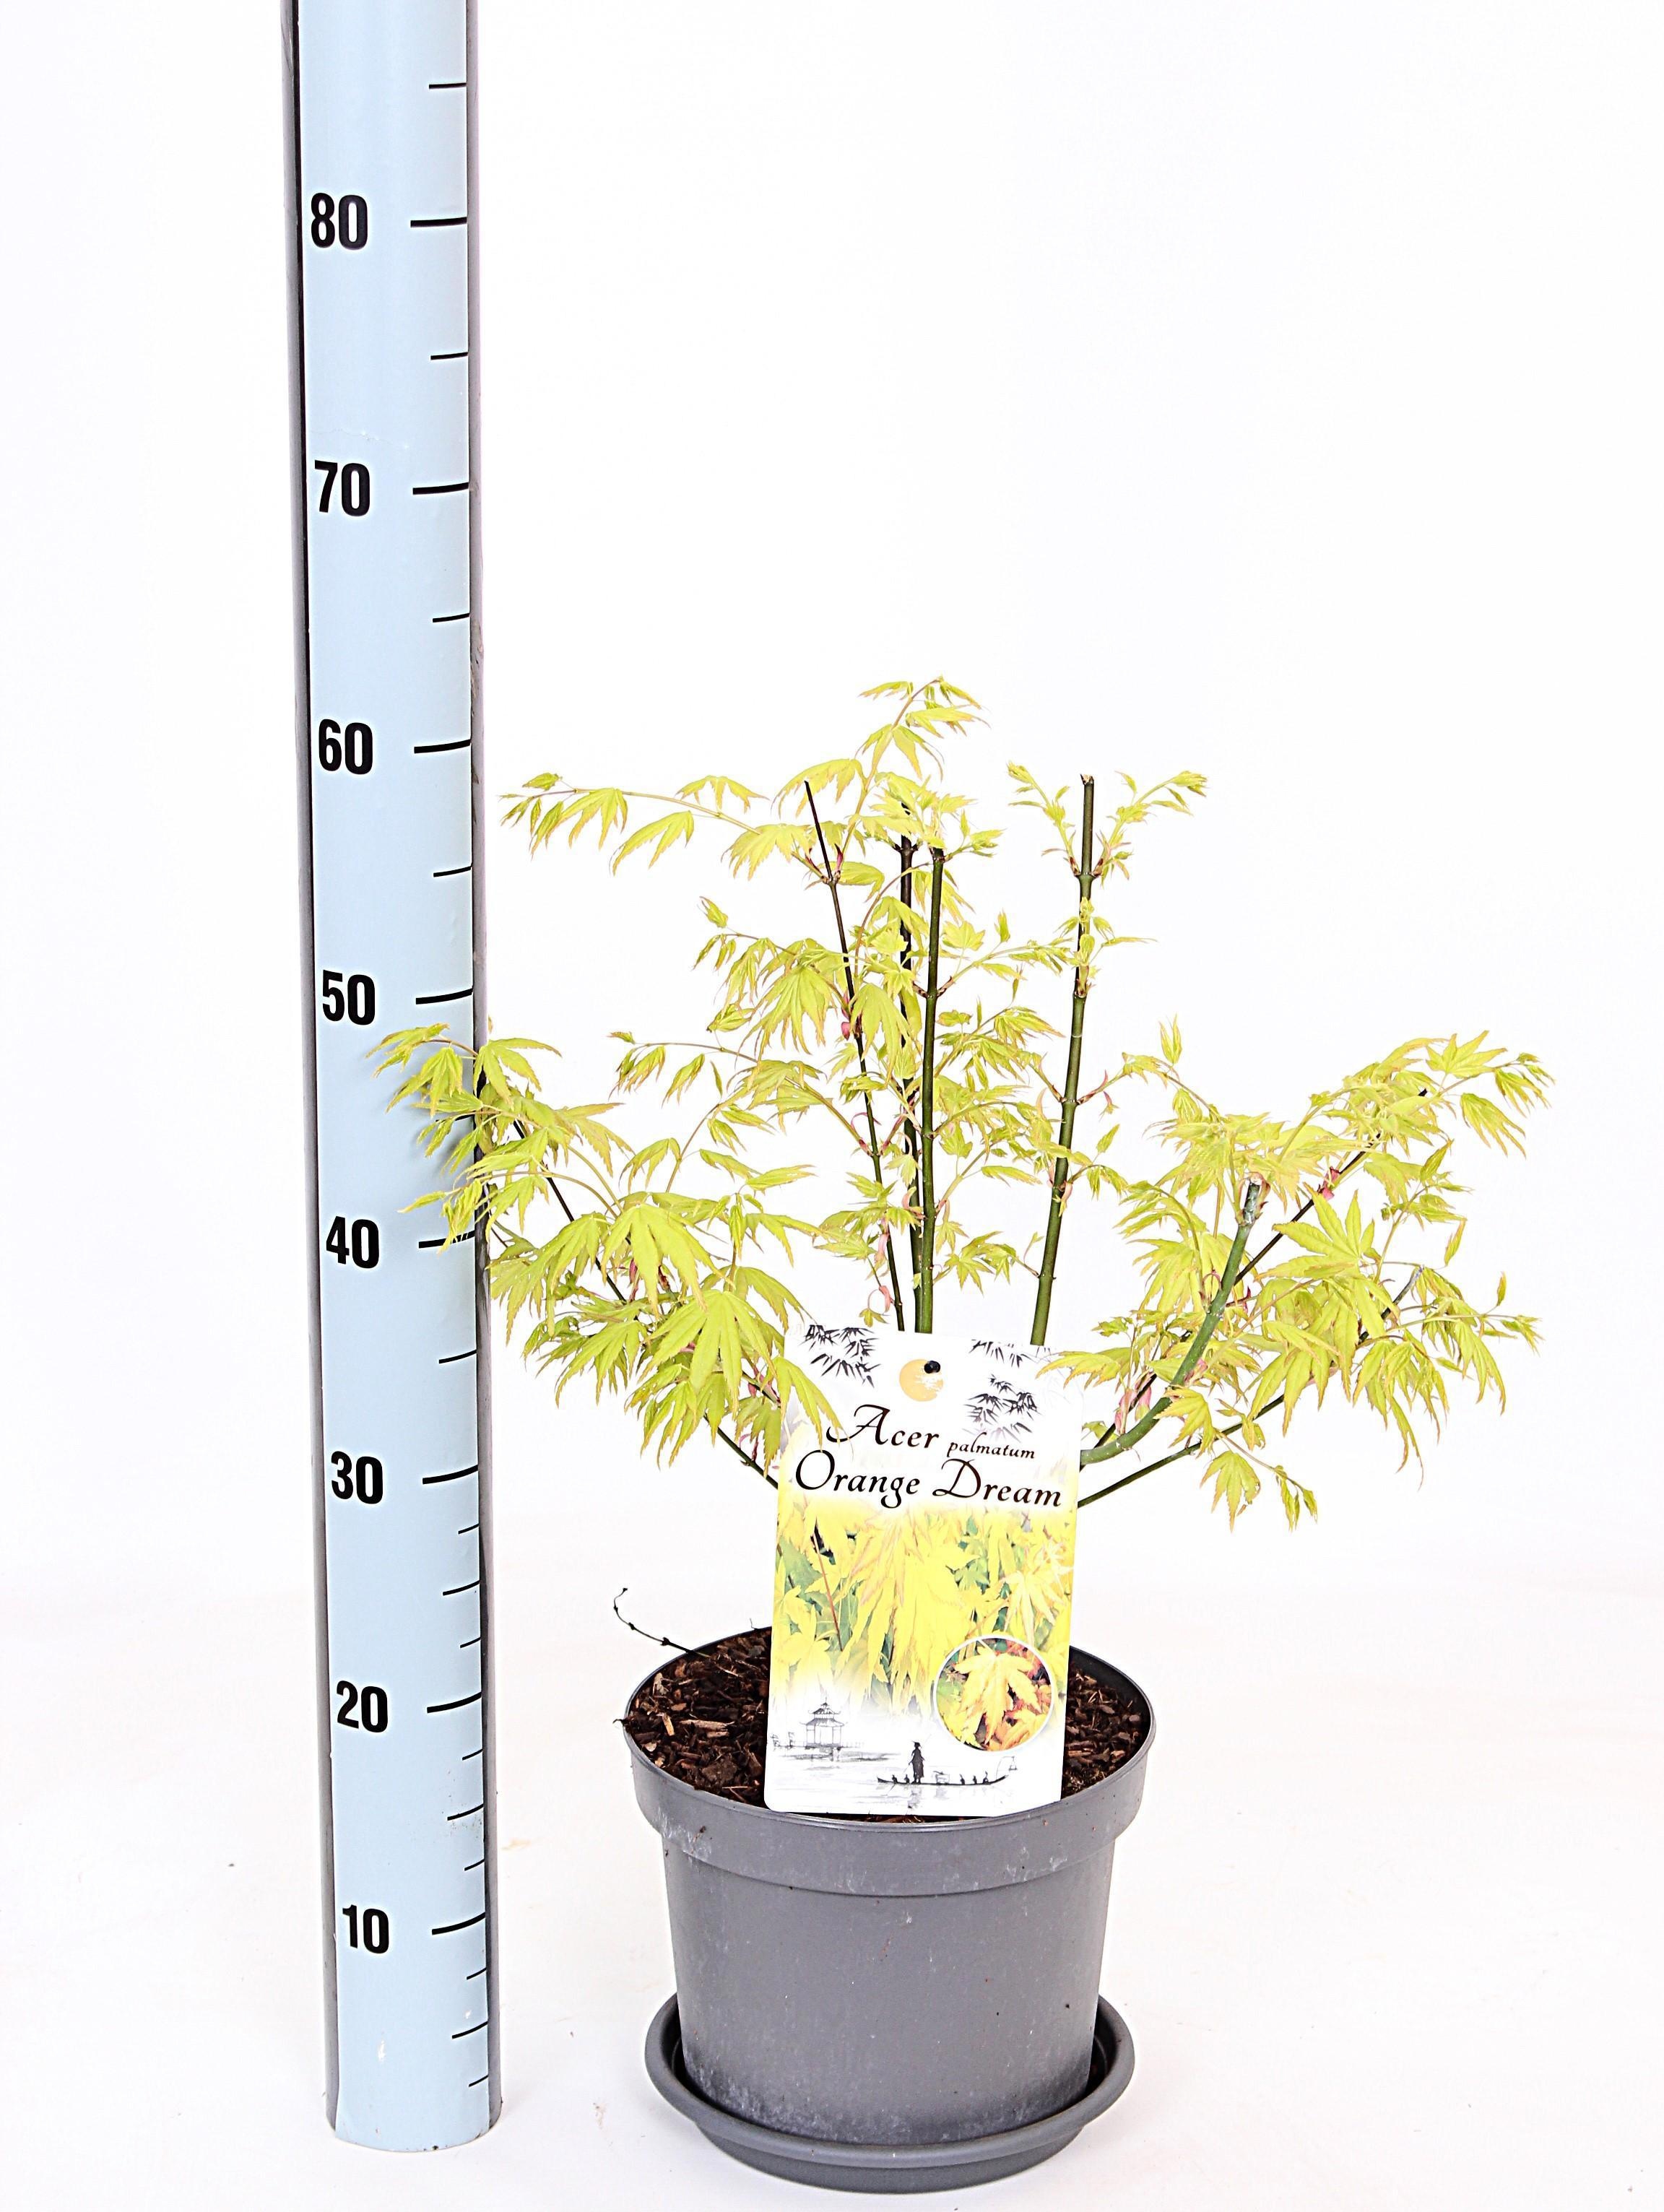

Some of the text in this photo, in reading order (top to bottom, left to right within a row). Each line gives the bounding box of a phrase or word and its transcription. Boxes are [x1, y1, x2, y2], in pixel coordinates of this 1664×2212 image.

[311, 193, 368, 249] 80
[315, 460, 370, 516] 70
[319, 719, 373, 774] 60
[323, 970, 375, 1025] 50
[326, 1216, 379, 1268] 40
[826, 1404, 1036, 1460] Acer palmatum
[332, 1452, 383, 1504] 30
[794, 1449, 1062, 1509] Orange Dream
[337, 1680, 388, 1732] 20
[342, 1905, 389, 1953] 10
